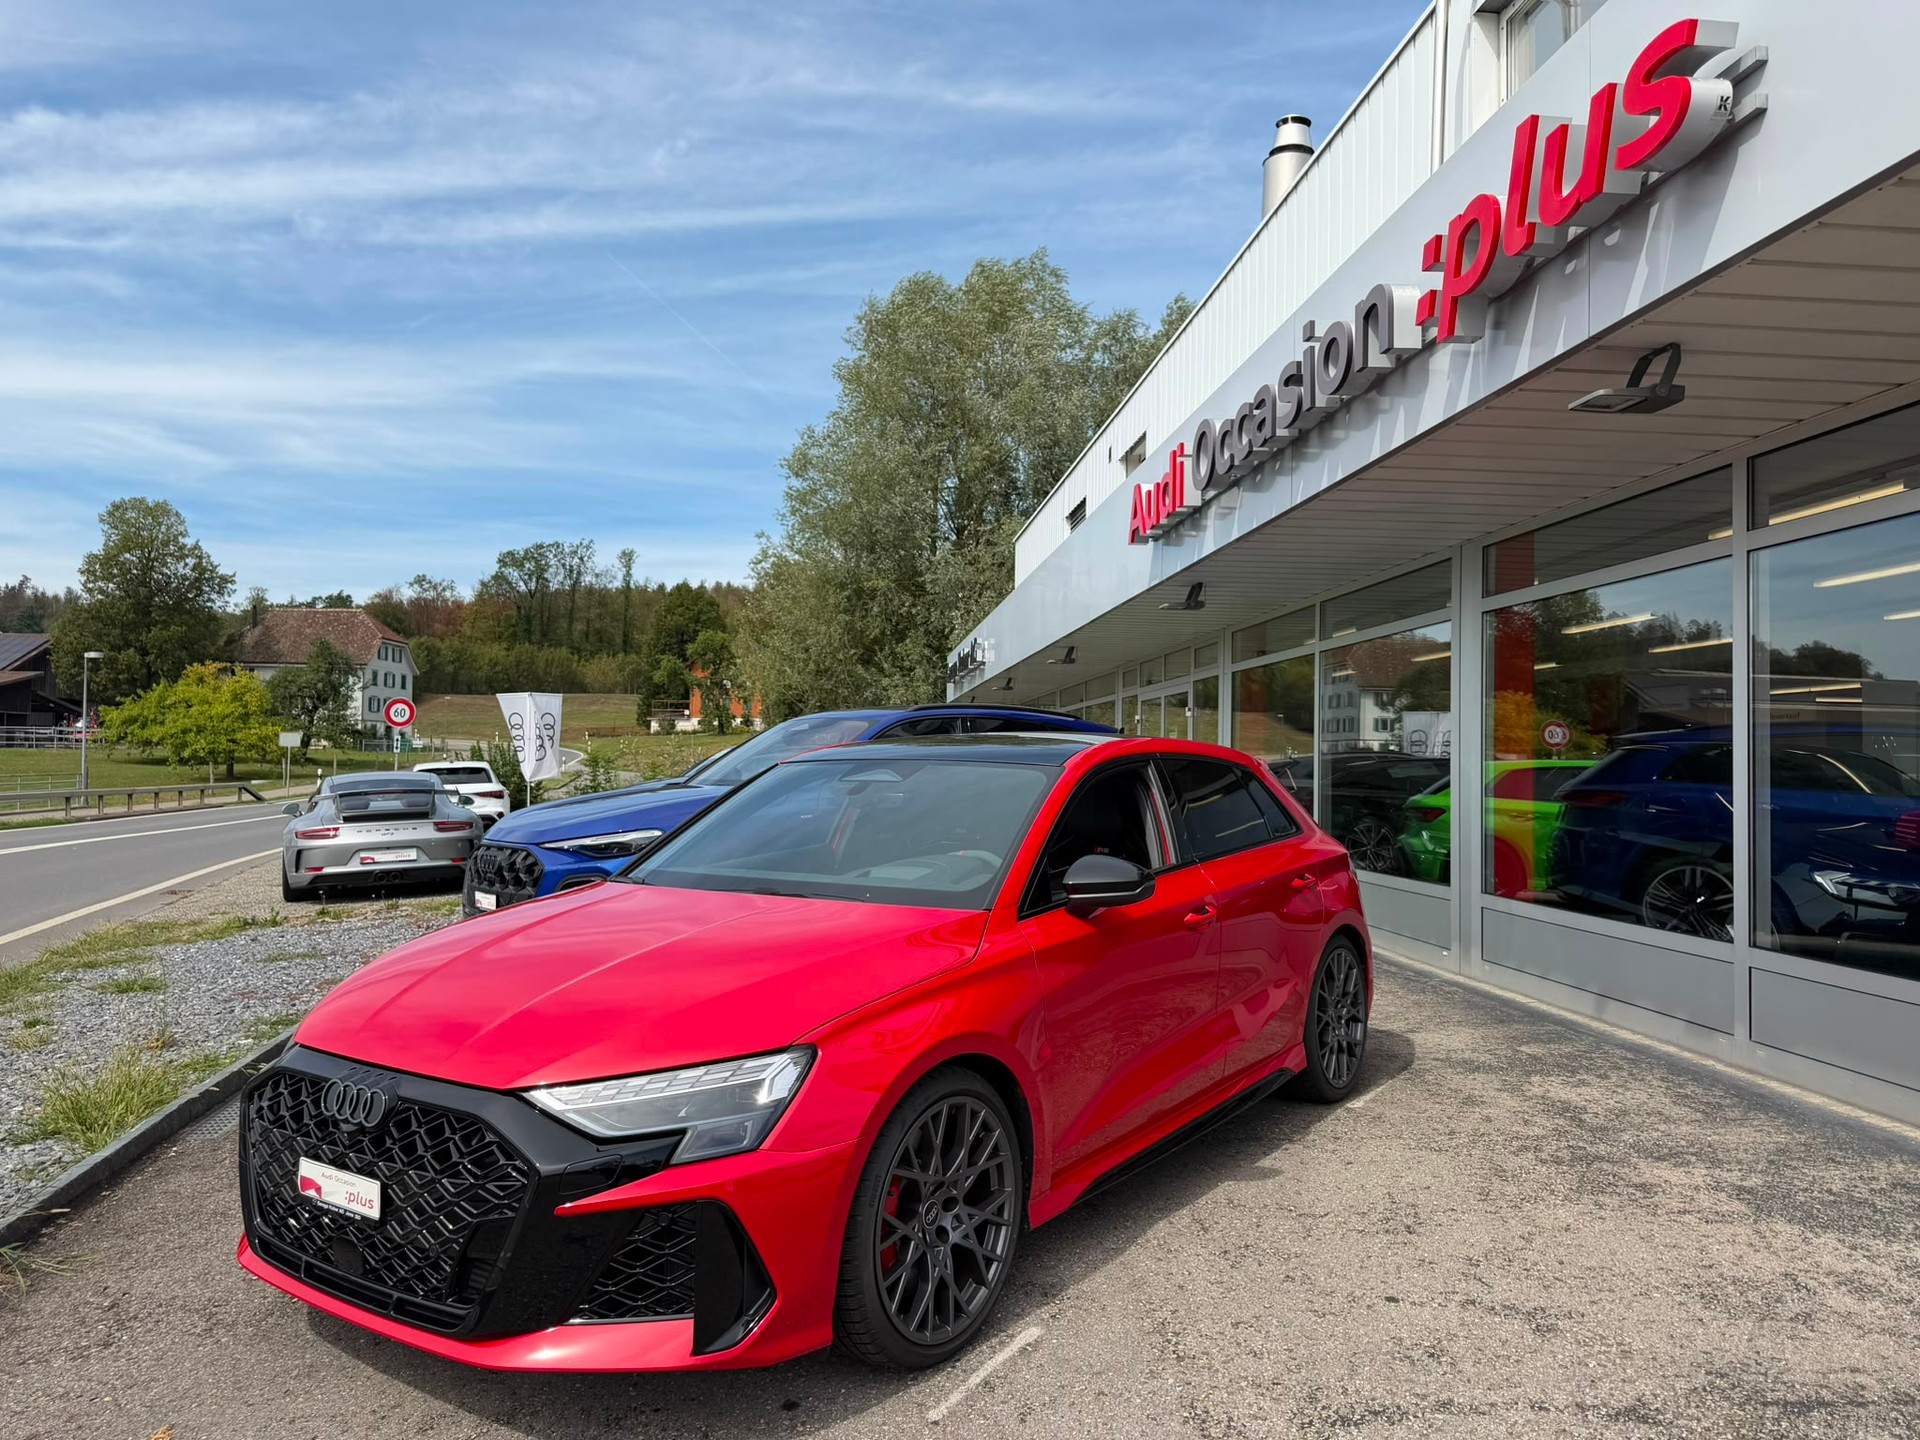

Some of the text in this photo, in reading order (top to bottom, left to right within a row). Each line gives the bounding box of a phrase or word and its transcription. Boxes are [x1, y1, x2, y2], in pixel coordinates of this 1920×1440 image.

[1127, 18, 1700, 544] Audi Occasion :plus
[393, 707, 406, 718] 60
[345, 1190, 375, 1209] :plus
